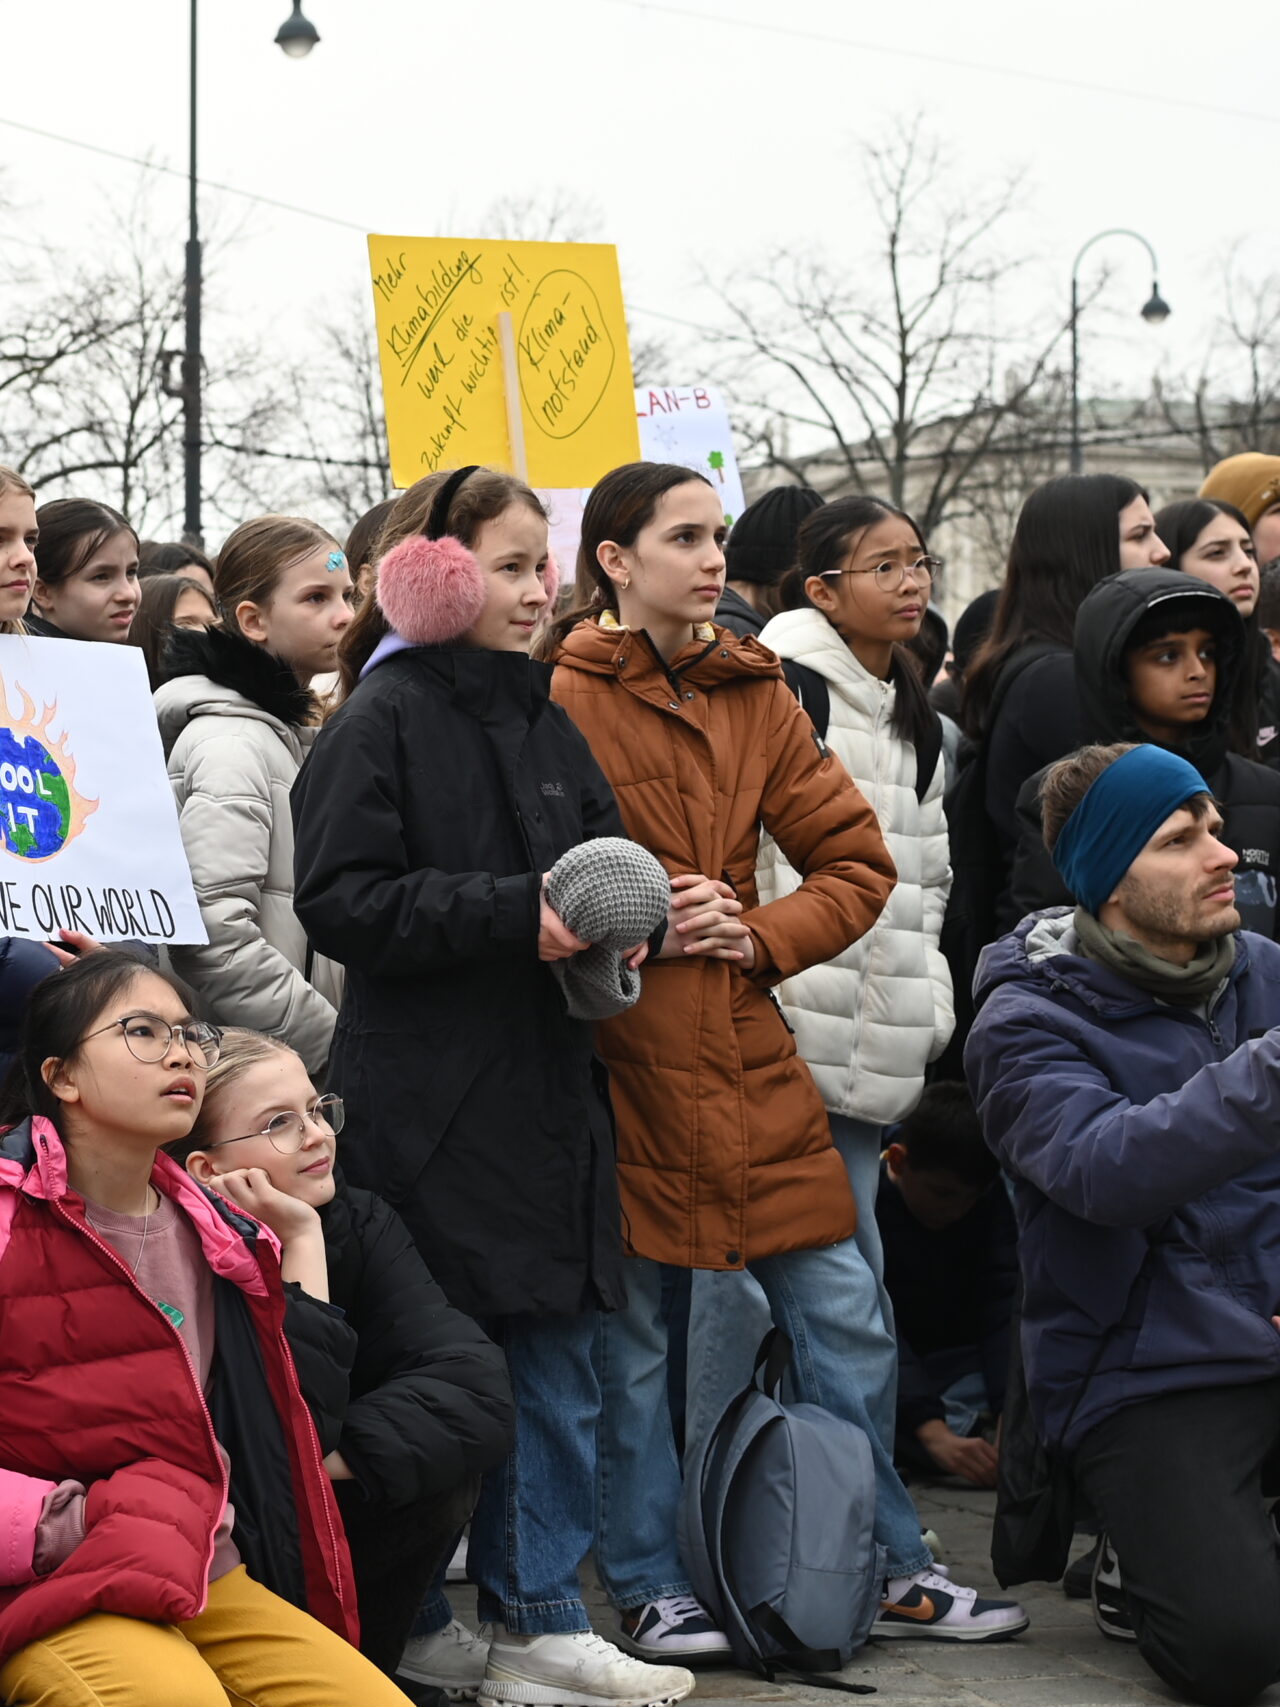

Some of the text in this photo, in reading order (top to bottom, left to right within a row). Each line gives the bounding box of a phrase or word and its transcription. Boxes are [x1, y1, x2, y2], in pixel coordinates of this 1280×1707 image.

[373, 251, 408, 303] Mehr
[386, 250, 483, 360] Klimabildung
[416, 313, 474, 400] weil die
[521, 292, 571, 373] Klima-
[541, 305, 603, 428] notstand
[420, 396, 468, 473] Zukunft
[636, 387, 711, 417] AN-B
[7, 802, 39, 835] IT
[31, 884, 94, 936] OUR
[87, 887, 176, 939] WORLD
